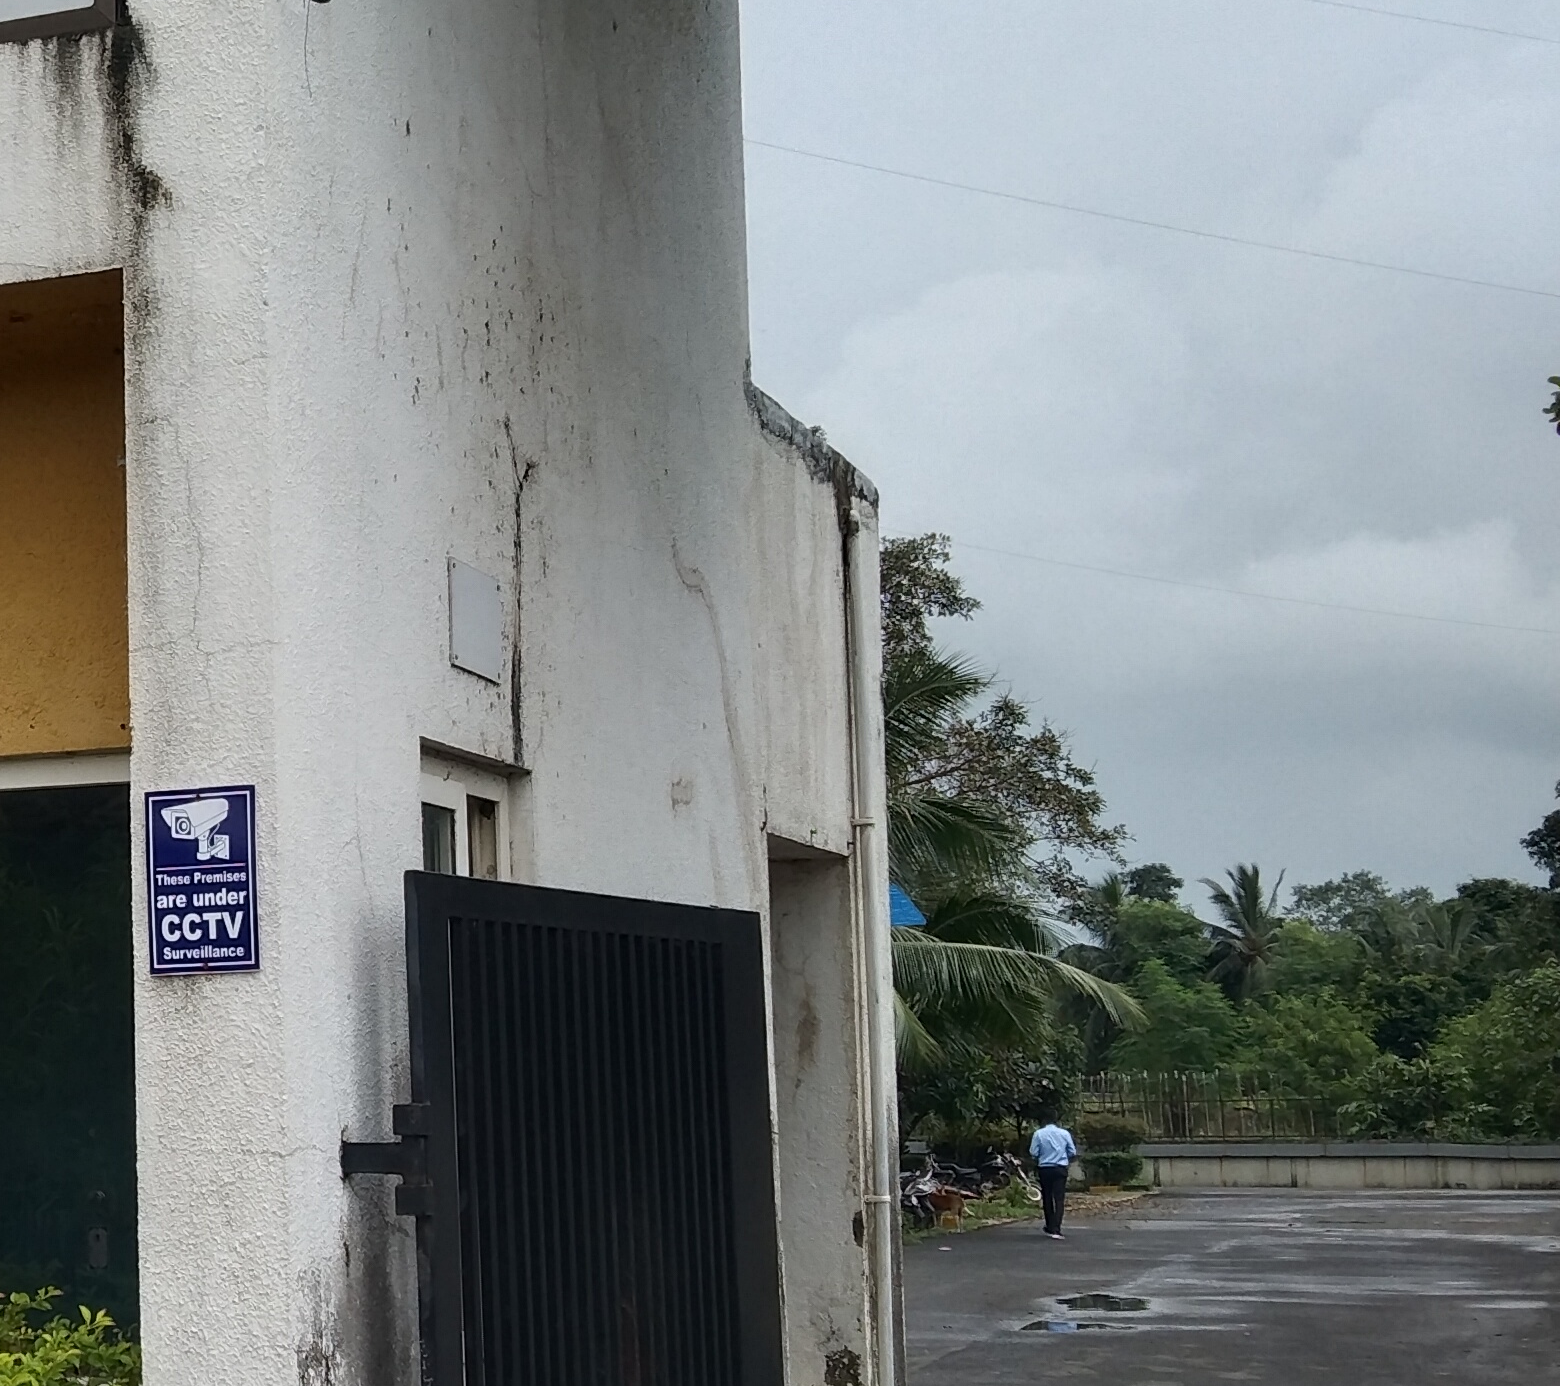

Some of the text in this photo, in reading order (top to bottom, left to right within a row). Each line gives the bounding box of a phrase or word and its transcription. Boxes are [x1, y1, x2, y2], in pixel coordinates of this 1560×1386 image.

[155, 870, 247, 886] These Premises
[156, 888, 247, 909] are under
[161, 911, 244, 942] CCTV
[163, 945, 245, 960] Surveillance
